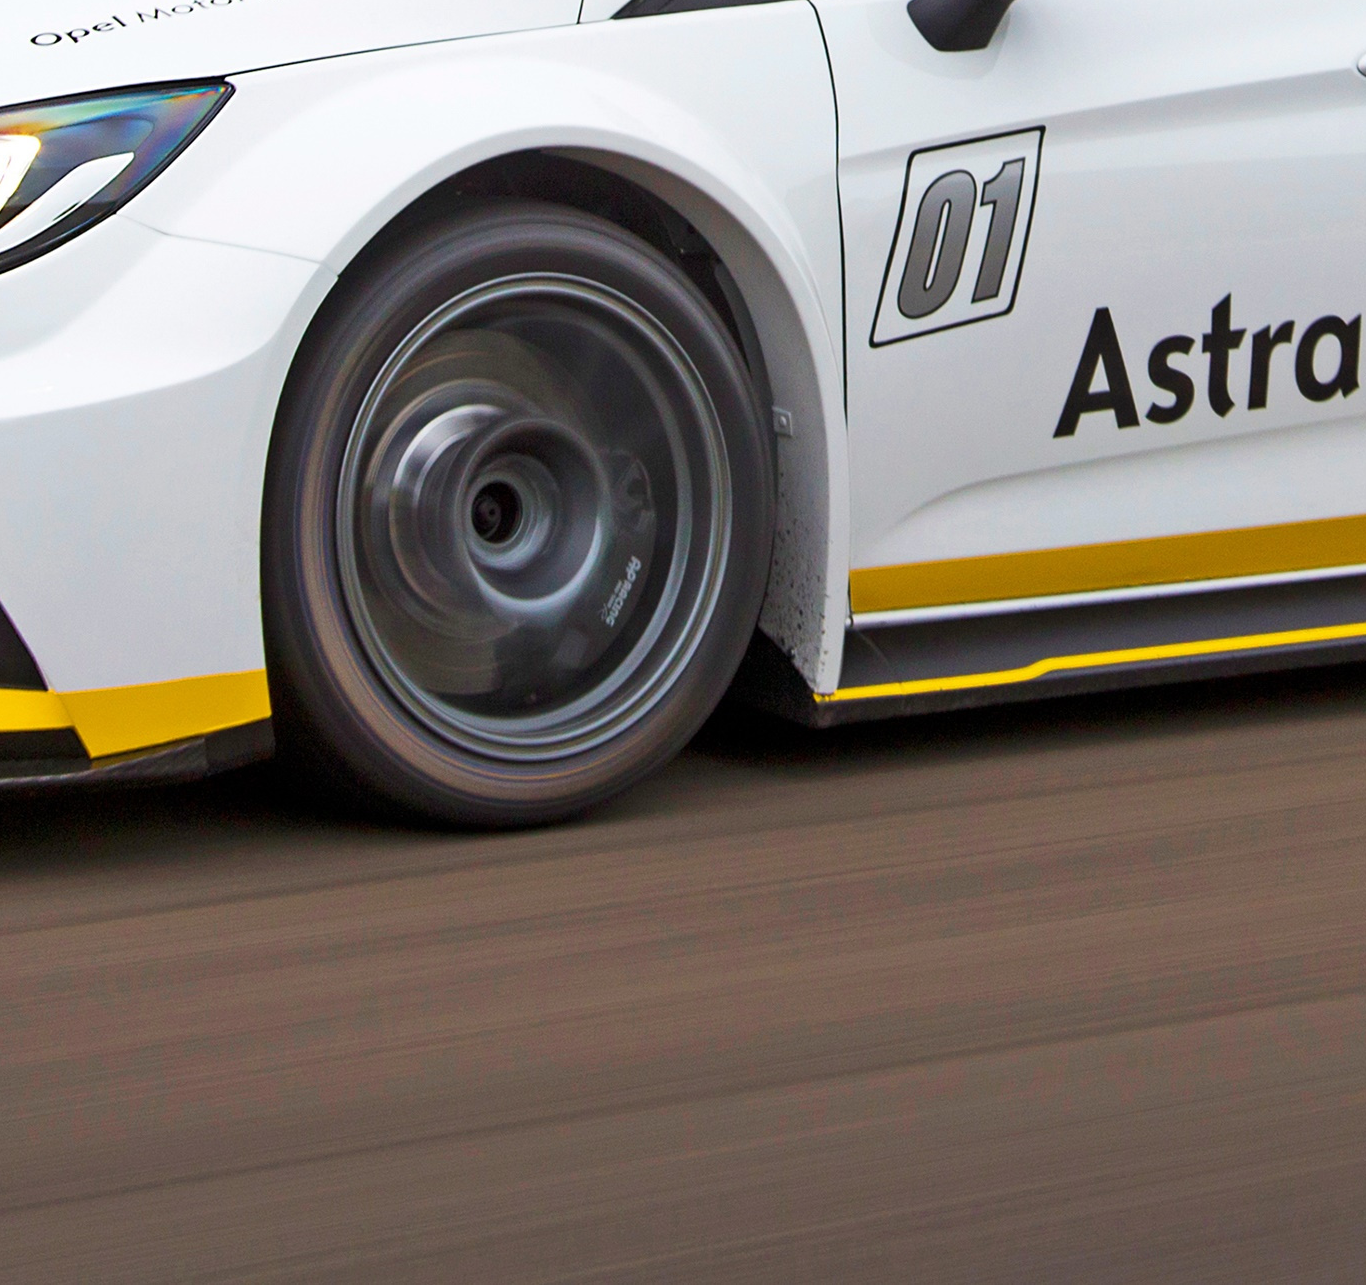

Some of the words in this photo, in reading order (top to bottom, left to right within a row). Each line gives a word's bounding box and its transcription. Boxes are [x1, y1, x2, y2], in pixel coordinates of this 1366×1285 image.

[30, 15, 128, 46] Opel
[897, 157, 1026, 319] 01
[1053, 292, 1363, 439] Astra
